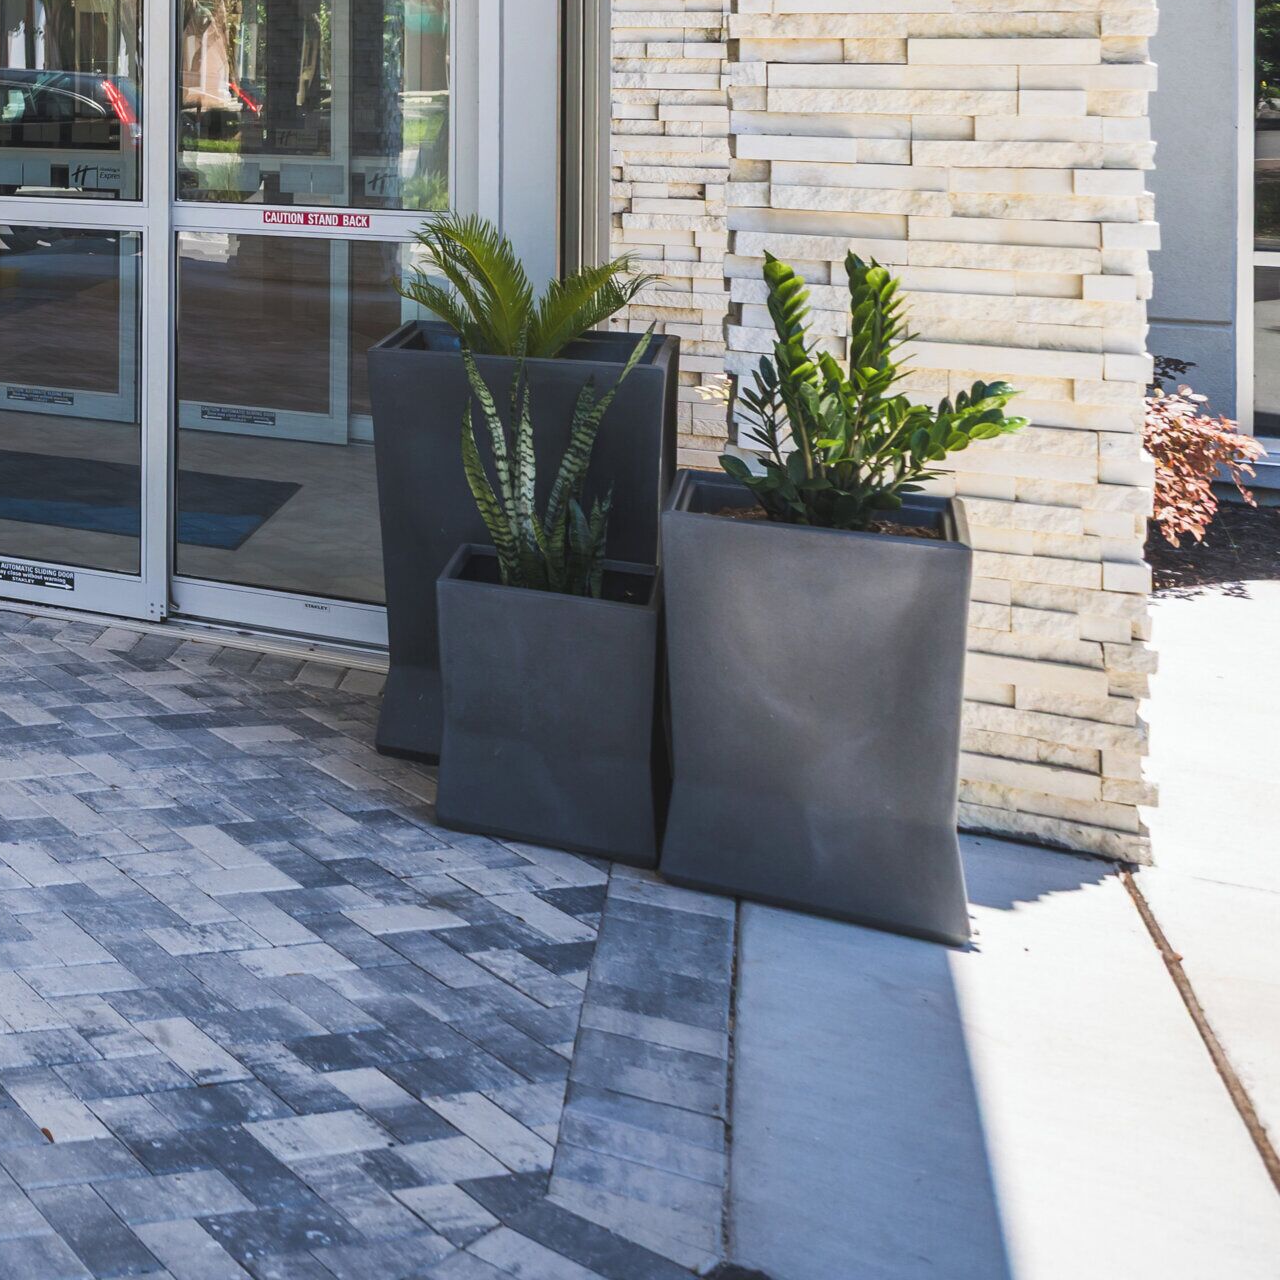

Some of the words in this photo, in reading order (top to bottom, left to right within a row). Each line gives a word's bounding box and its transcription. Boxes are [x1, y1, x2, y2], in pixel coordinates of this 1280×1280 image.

[264, 211, 304, 224] CAUTION
[307, 213, 339, 226] STAND
[342, 215, 368, 228] BACK
[0, 562, 33, 573] AUTOMATIC
[34, 567, 57, 577] SLIDING
[57, 571, 74, 579] DOOR
